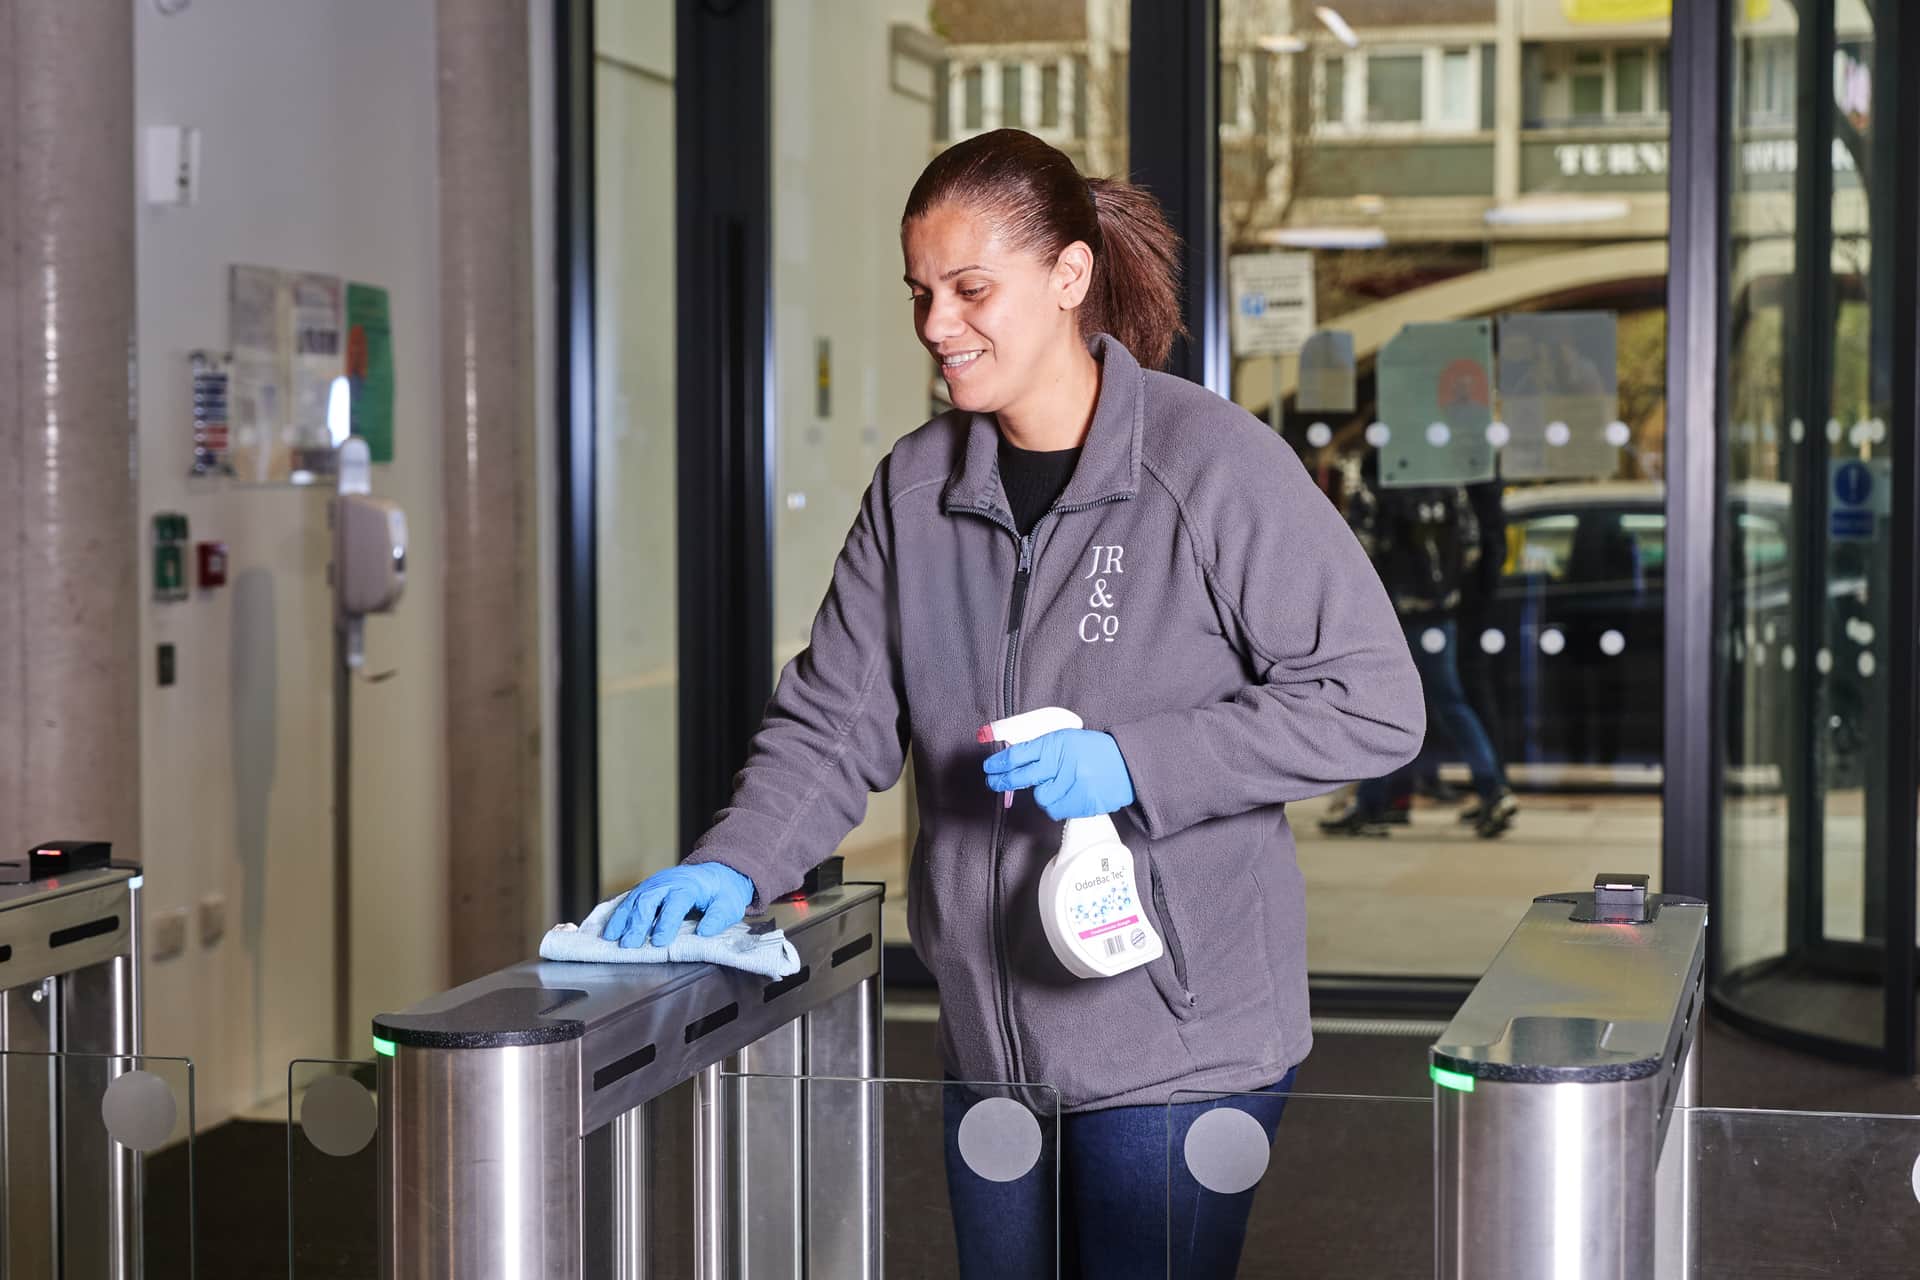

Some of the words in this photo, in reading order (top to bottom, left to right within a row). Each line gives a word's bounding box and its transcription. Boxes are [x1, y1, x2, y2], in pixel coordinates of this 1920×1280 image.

[1085, 545, 1124, 579] JR
[1090, 578, 1114, 608] &
[1075, 875, 1110, 891] OdorBac
[1111, 871, 1124, 881] Tec
